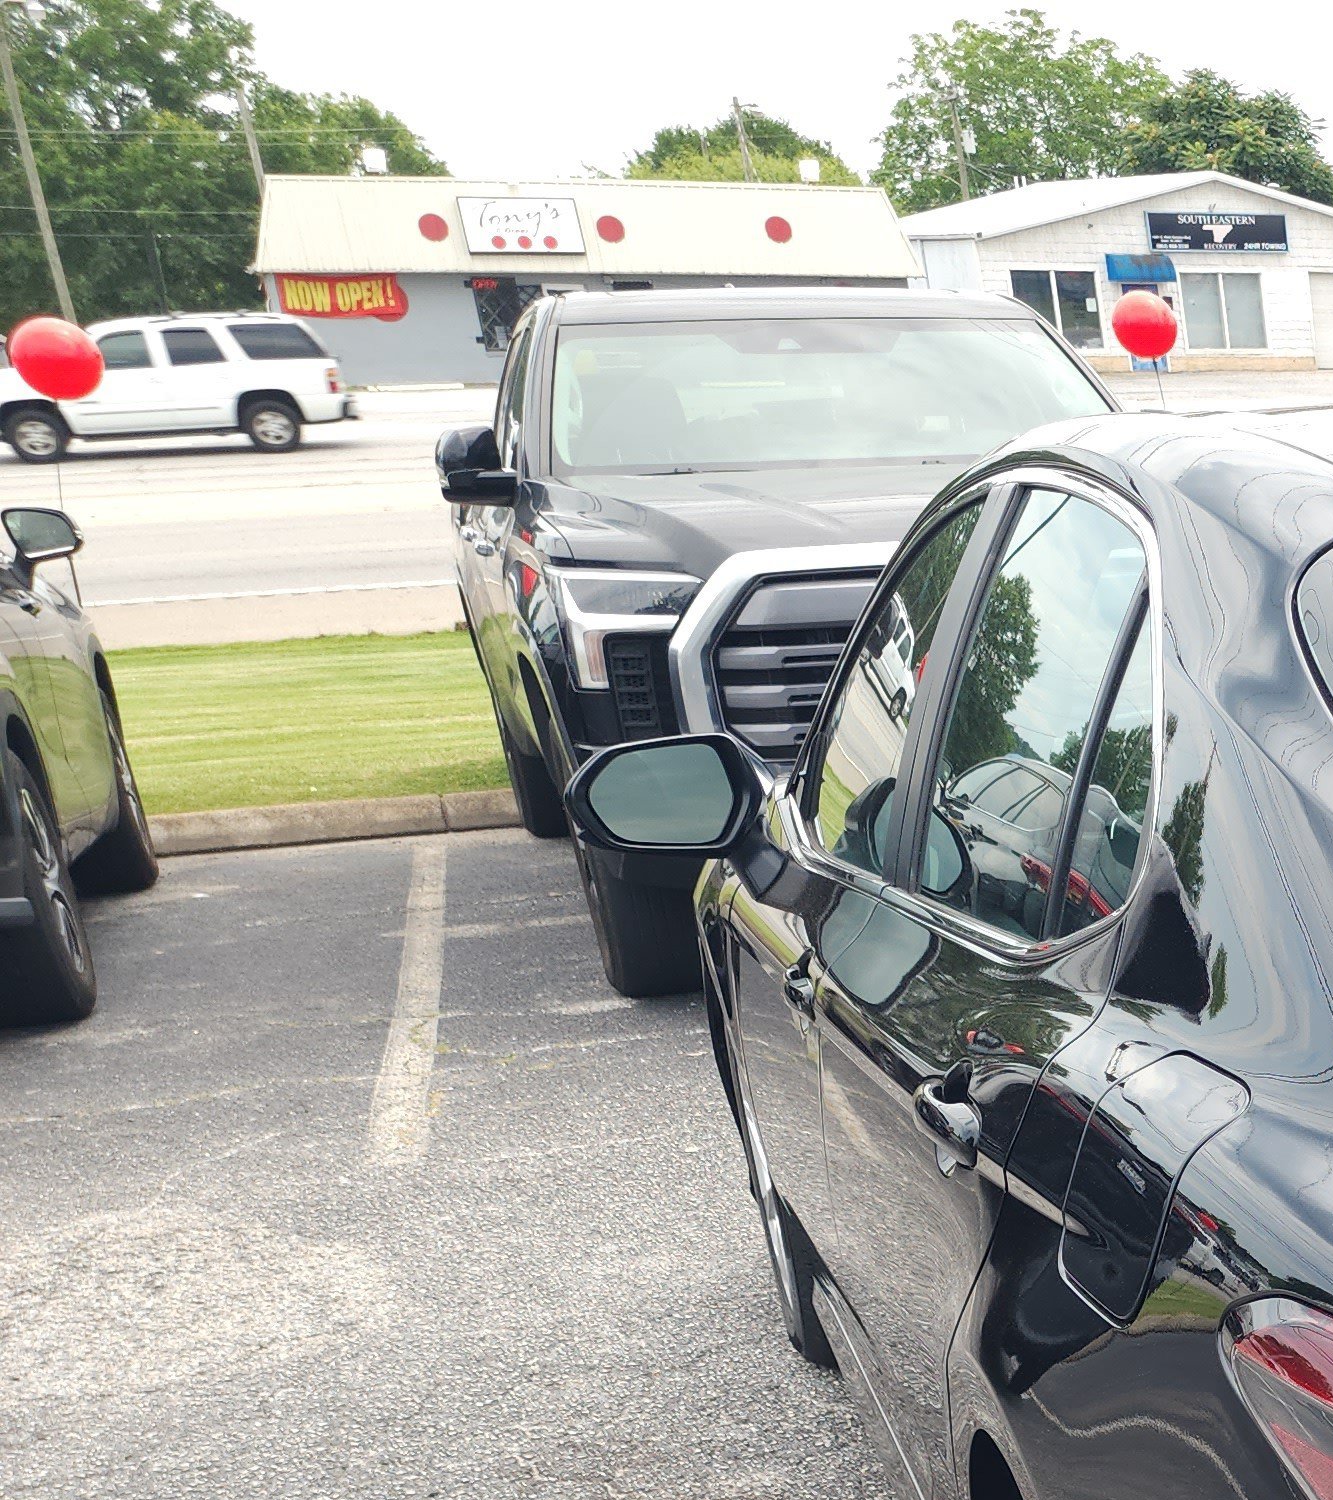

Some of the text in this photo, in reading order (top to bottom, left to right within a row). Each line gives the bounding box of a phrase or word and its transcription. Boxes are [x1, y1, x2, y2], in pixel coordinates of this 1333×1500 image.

[1177, 214, 1256, 226] SOUTH EASTERN
[283, 277, 396, 312] NOW OPEN!
